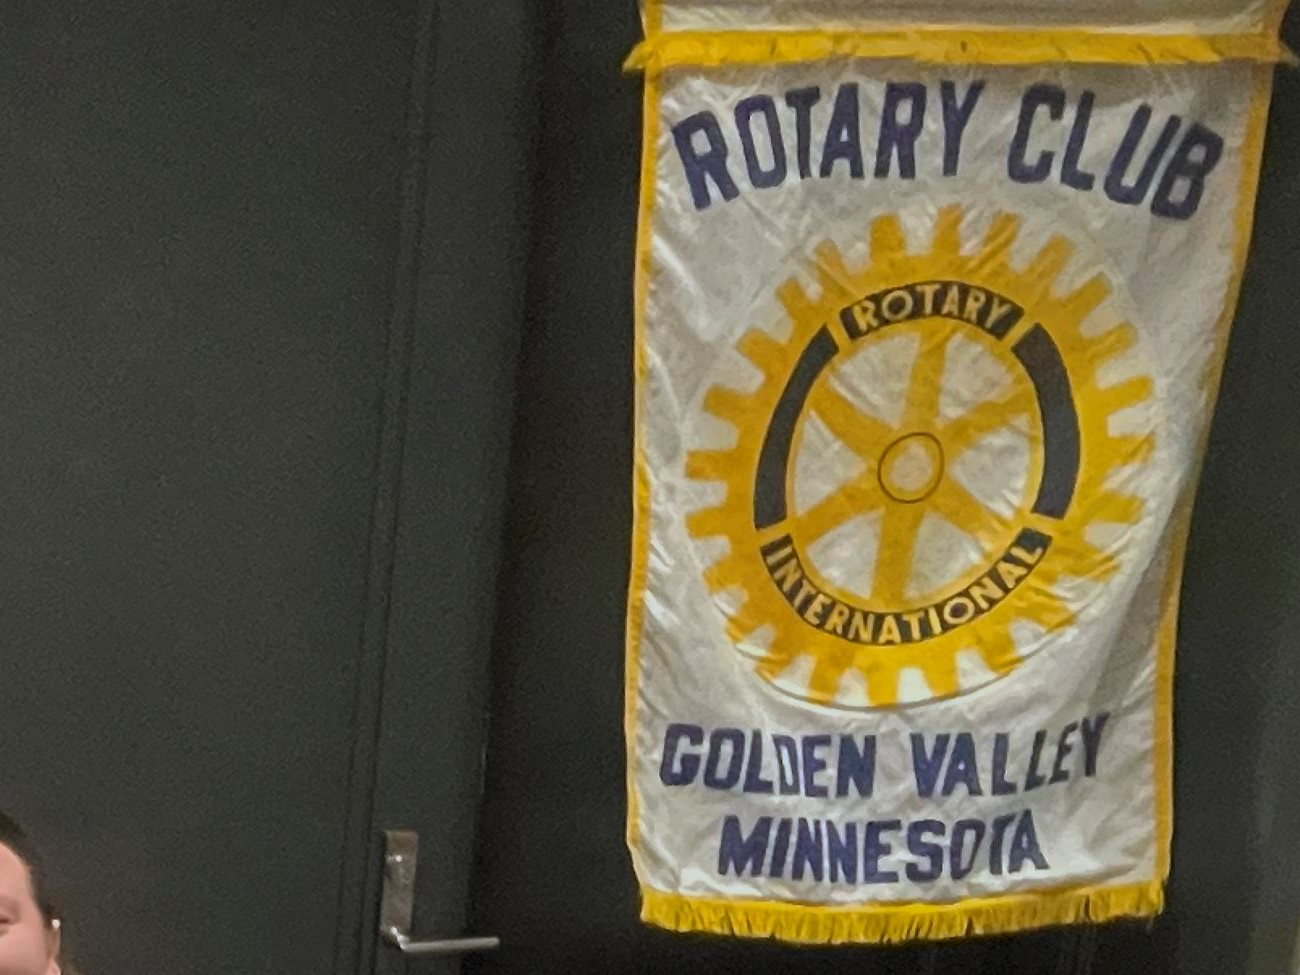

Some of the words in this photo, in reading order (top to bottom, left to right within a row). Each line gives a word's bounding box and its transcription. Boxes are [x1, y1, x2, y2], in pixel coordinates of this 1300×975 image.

[672, 80, 984, 210] ROTARY
[1007, 83, 1223, 220] CLUB
[851, 284, 1013, 333] ROTARY
[765, 542, 1043, 645] INTERNATIONAL
[659, 723, 877, 798] GOLDEN
[910, 712, 1110, 798] VALLEY
[717, 809, 1050, 884] MINNESOTA
